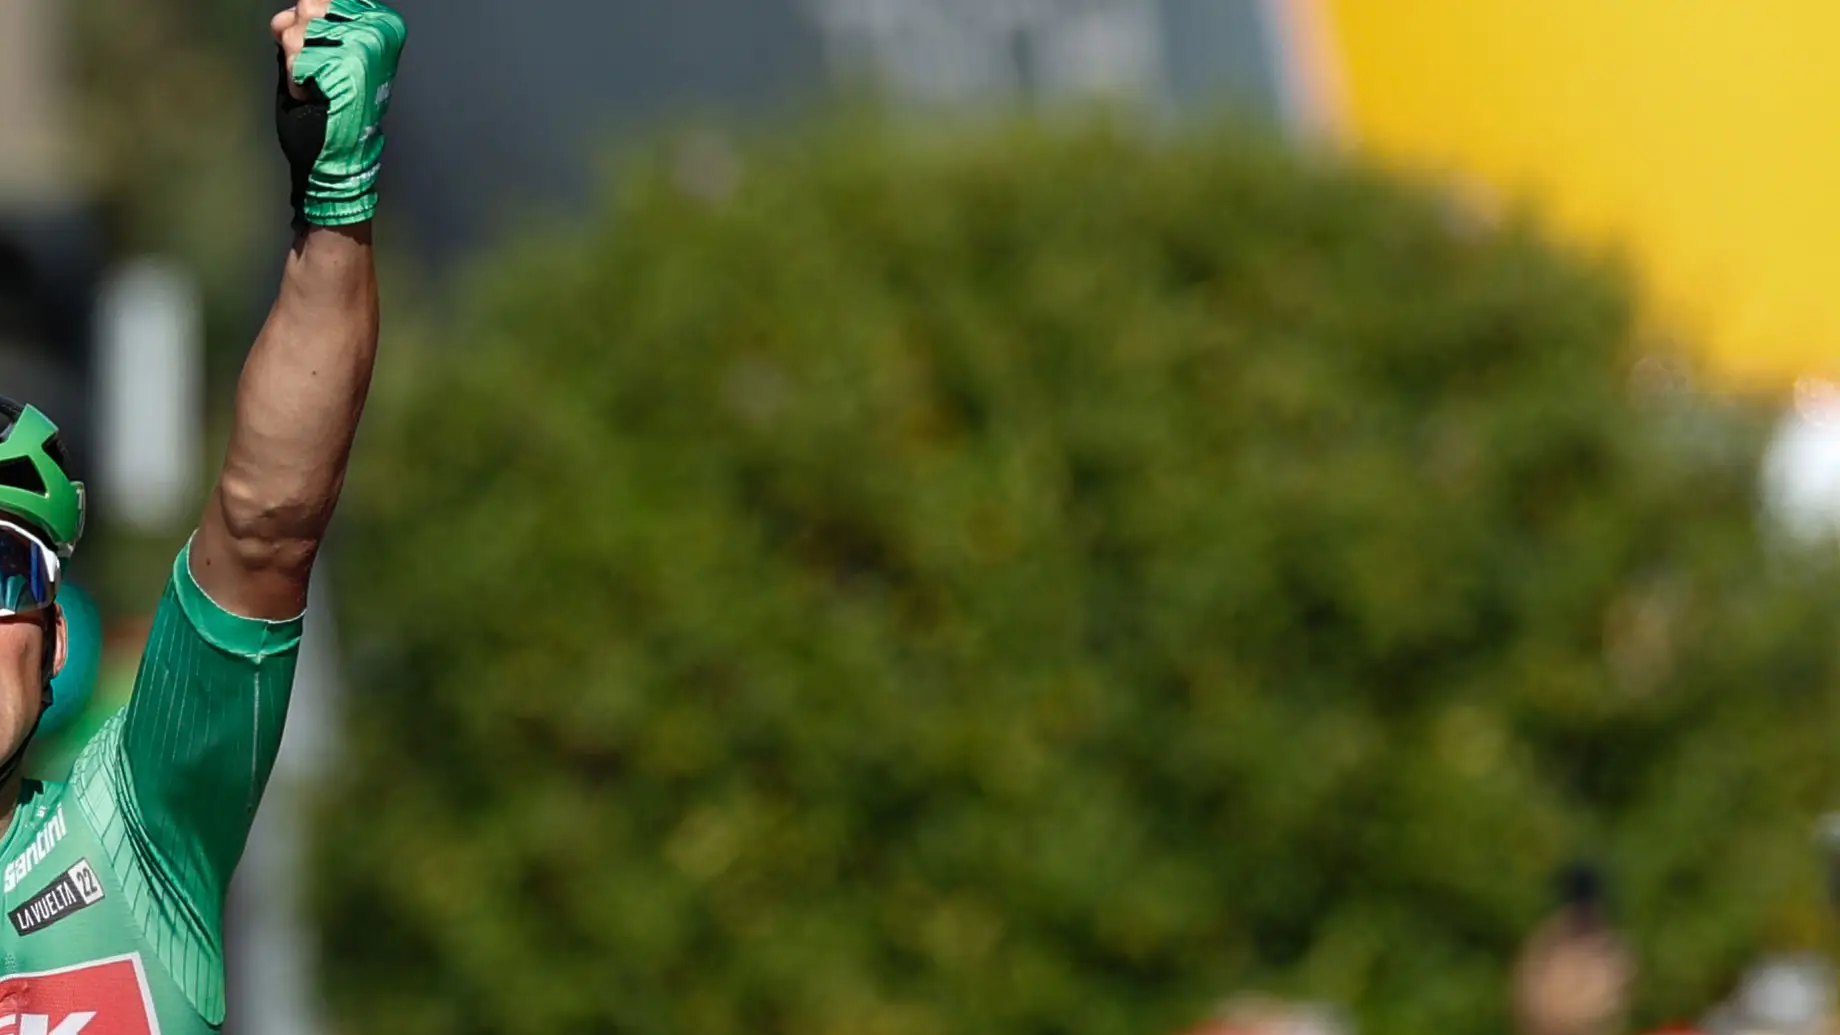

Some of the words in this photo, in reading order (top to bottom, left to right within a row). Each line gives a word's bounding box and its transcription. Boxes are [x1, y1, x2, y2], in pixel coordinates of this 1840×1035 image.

[3, 801, 67, 893] Santini
[16, 908, 34, 930] LA
[30, 880, 77, 923] VUELTA
[75, 867, 98, 896] 22
